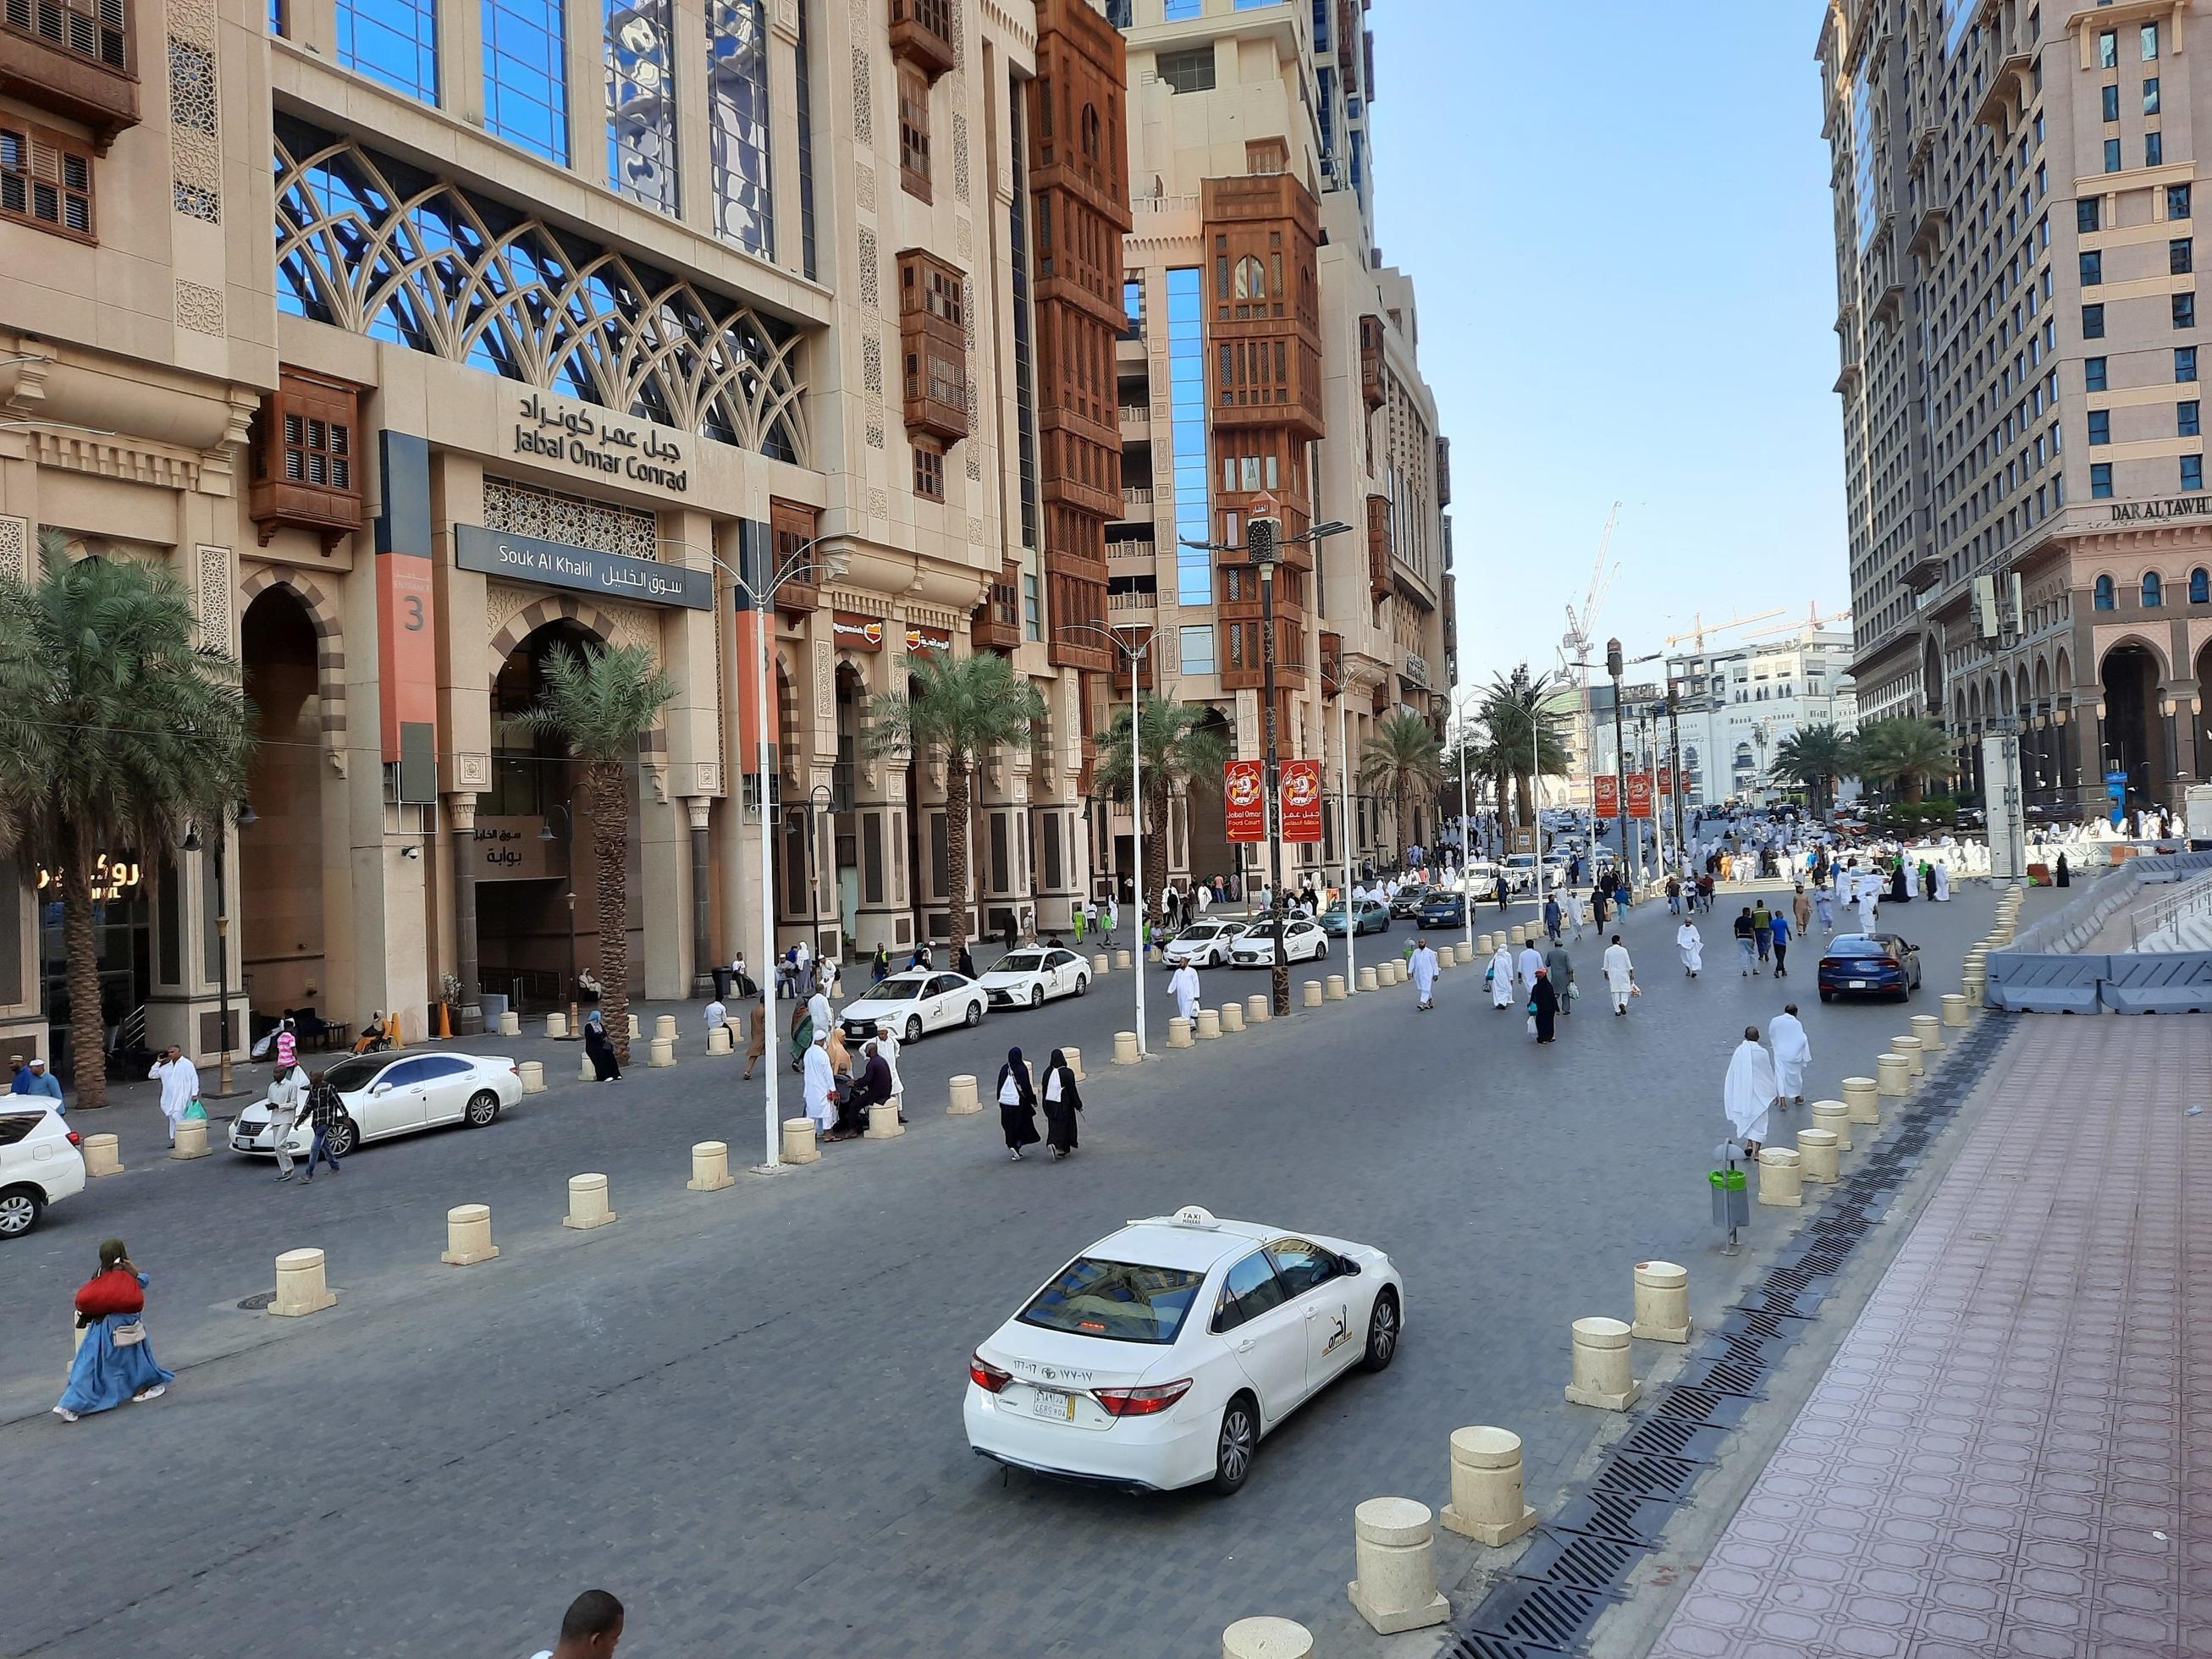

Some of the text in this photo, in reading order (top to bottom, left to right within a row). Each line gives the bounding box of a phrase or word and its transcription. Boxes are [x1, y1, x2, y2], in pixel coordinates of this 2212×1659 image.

[520, 393, 681, 464] جبل عمر كونراد
[514, 423, 687, 492] Jabal Omar Conrad
[2111, 503, 2143, 521] DAR
[499, 544, 593, 578] Souk Al Khalil
[601, 565, 682, 595] سوق الخليل
[405, 595, 424, 631] 3
[499, 829, 521, 841] سوق
[487, 846, 522, 867] بوابة
